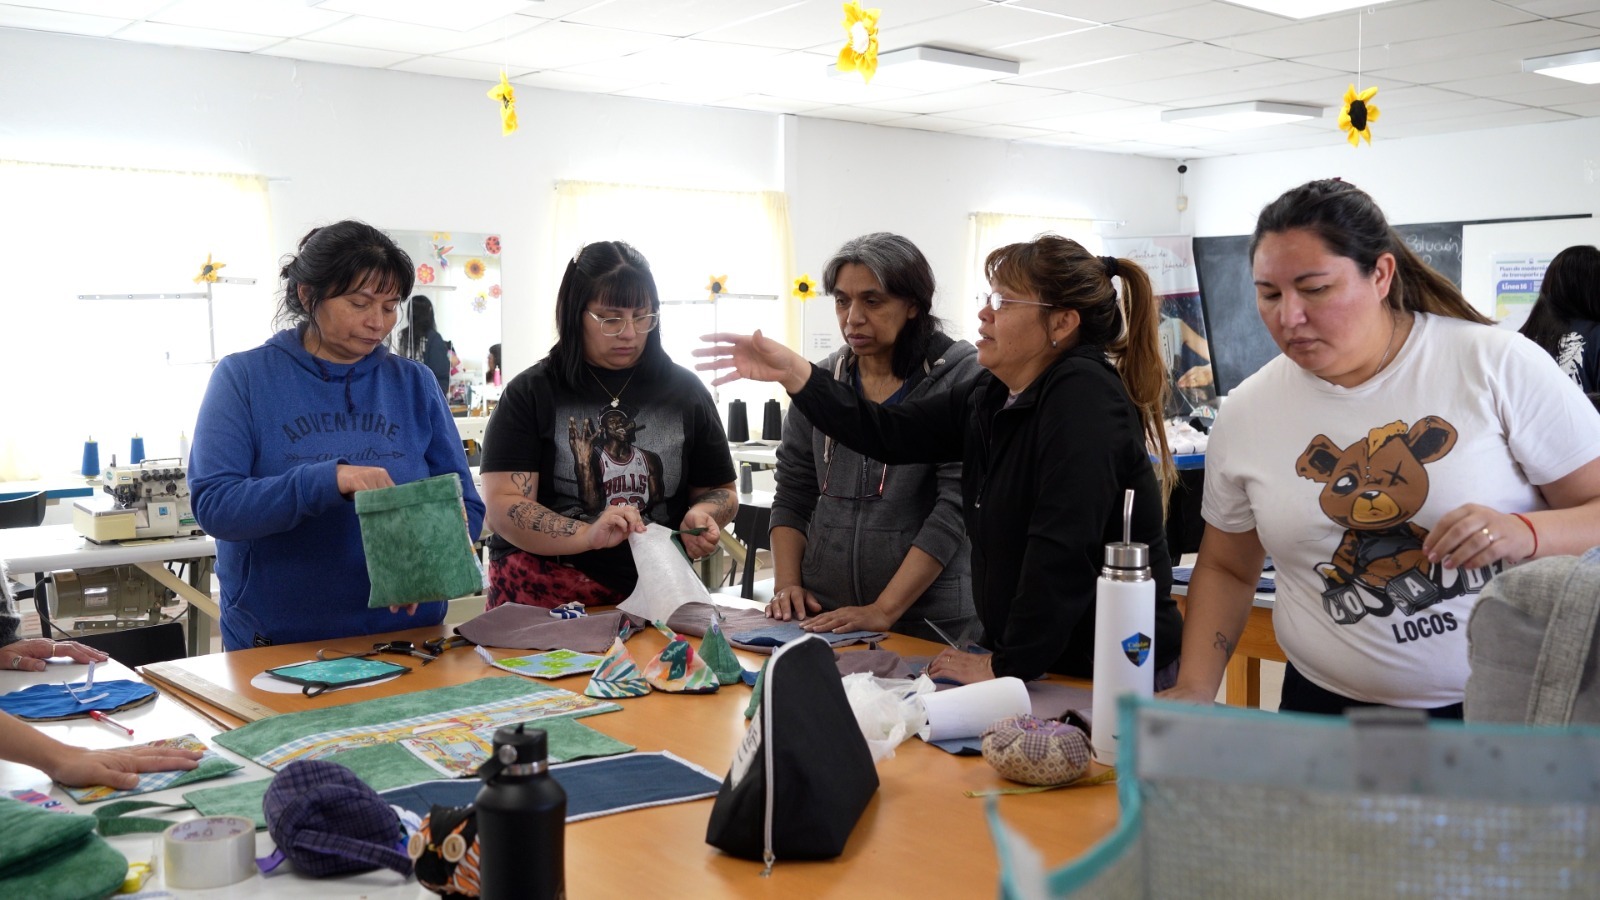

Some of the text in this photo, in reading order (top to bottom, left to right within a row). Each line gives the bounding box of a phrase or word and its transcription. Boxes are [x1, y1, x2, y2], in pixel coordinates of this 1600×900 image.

[1502, 282, 1519, 290] Línea
[282, 412, 400, 444] ADVENTURE
[603, 473, 647, 498] BULLS
[1392, 611, 1458, 644] LOCOS
